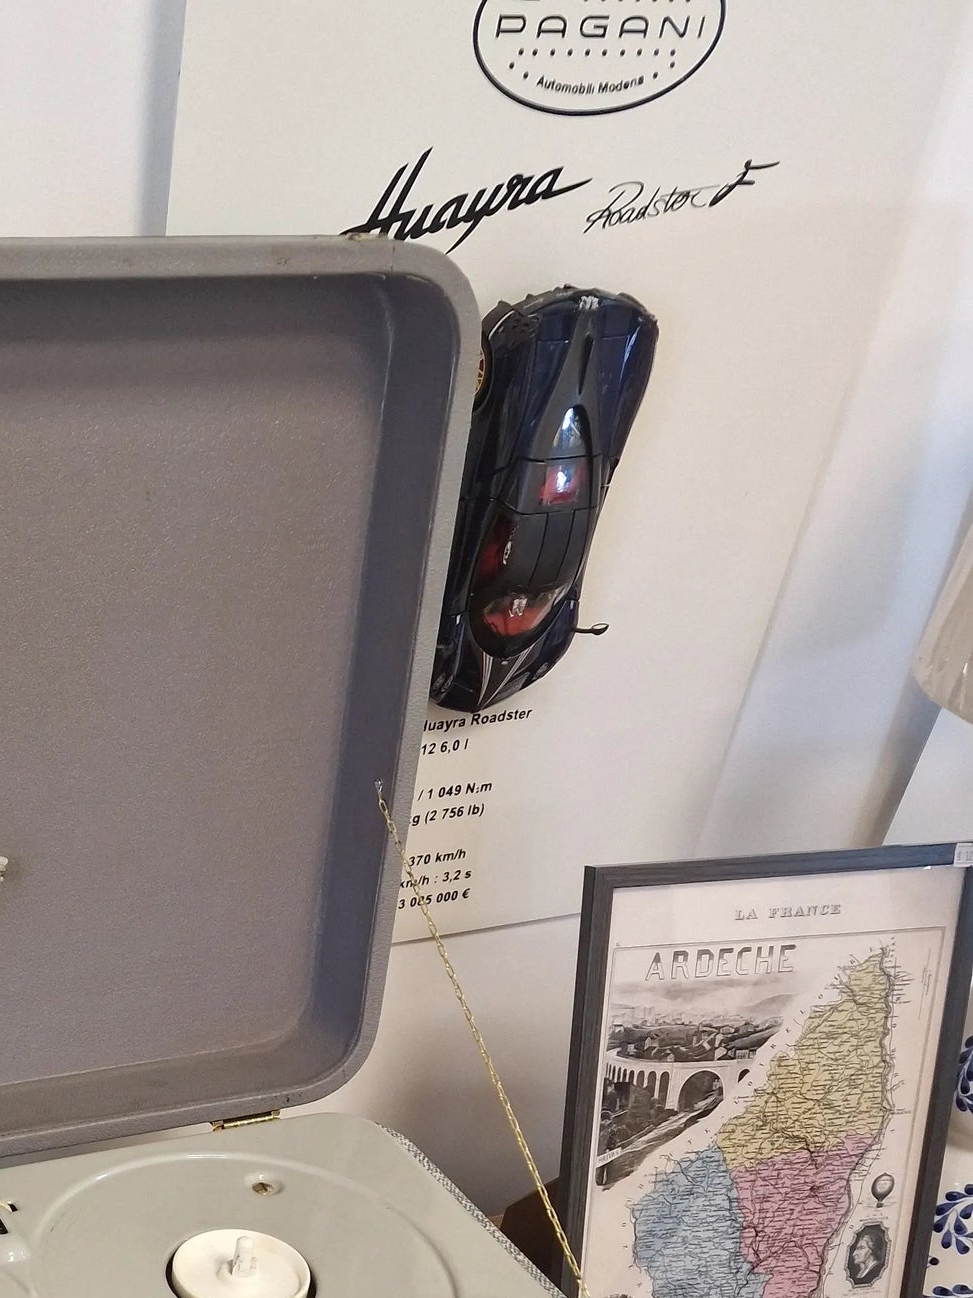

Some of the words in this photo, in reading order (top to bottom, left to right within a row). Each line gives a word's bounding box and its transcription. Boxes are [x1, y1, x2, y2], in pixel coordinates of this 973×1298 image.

[495, 14, 706, 40] PAGANI
[536, 75, 595, 95] Automobili
[598, 75, 645, 95] Modena
[339, 146, 593, 256] Huayra
[470, 708, 533, 727] Roadster
[440, 739, 461, 755] 6,0
[427, 788, 434, 799] 1
[438, 784, 463, 799] 049
[409, 814, 421, 827] g
[424, 809, 438, 825] (2
[442, 805, 465, 820] 756
[467, 802, 485, 818] lb)
[408, 854, 432, 867] 370
[435, 848, 467, 863] km/h
[442, 869, 462, 884] 3,2
[464, 870, 472, 879] s
[398, 898, 406, 910] 3
[436, 890, 459, 904] 000
[461, 887, 471, 900] €
[734, 909, 759, 921] LA
[768, 903, 842, 920] FRANCE
[644, 944, 797, 982] ARDECHE
